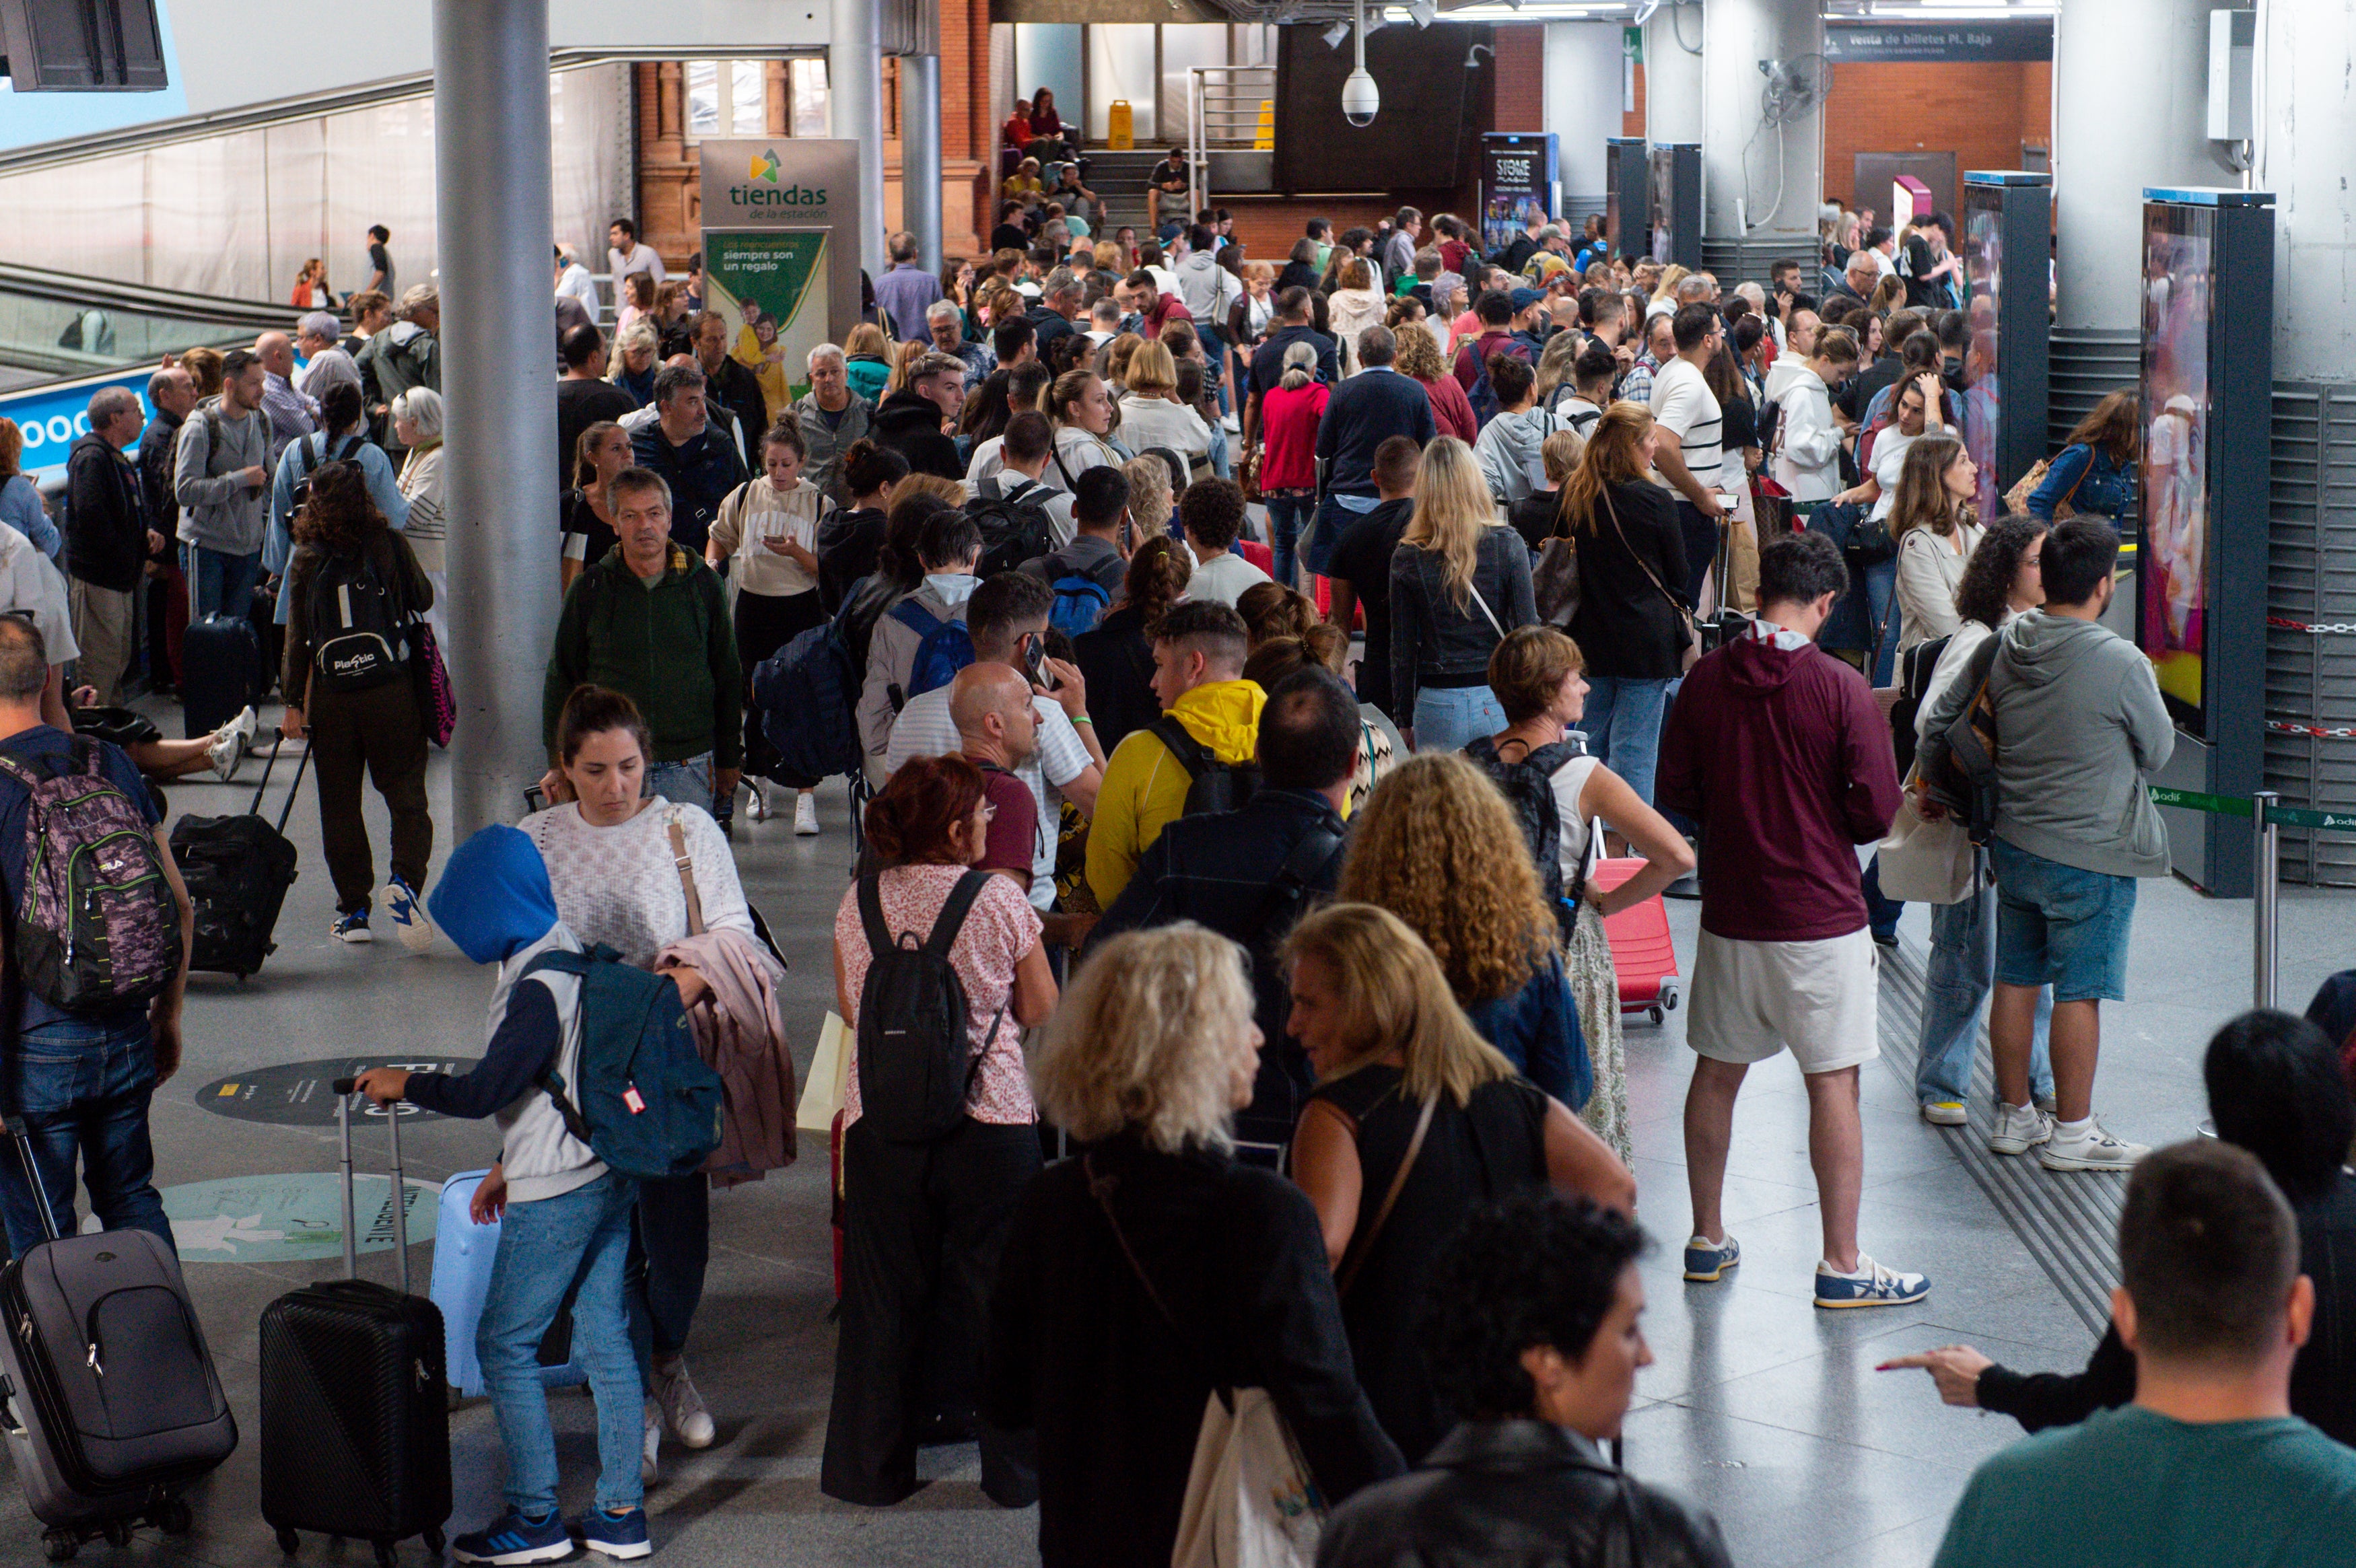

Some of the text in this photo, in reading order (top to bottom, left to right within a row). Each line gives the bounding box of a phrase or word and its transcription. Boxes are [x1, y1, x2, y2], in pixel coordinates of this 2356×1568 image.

[1850, 34, 1881, 45] Venta
[1885, 34, 1900, 44] de
[1904, 34, 1945, 44] billetes
[1968, 34, 1992, 46] Baja
[730, 184, 827, 205] tiendas
[749, 209, 828, 219] de la estación
[723, 250, 794, 261] siempre son
[723, 261, 778, 273] un regalo
[2160, 792, 2181, 802] adif
[99, 859, 124, 874] FILA
